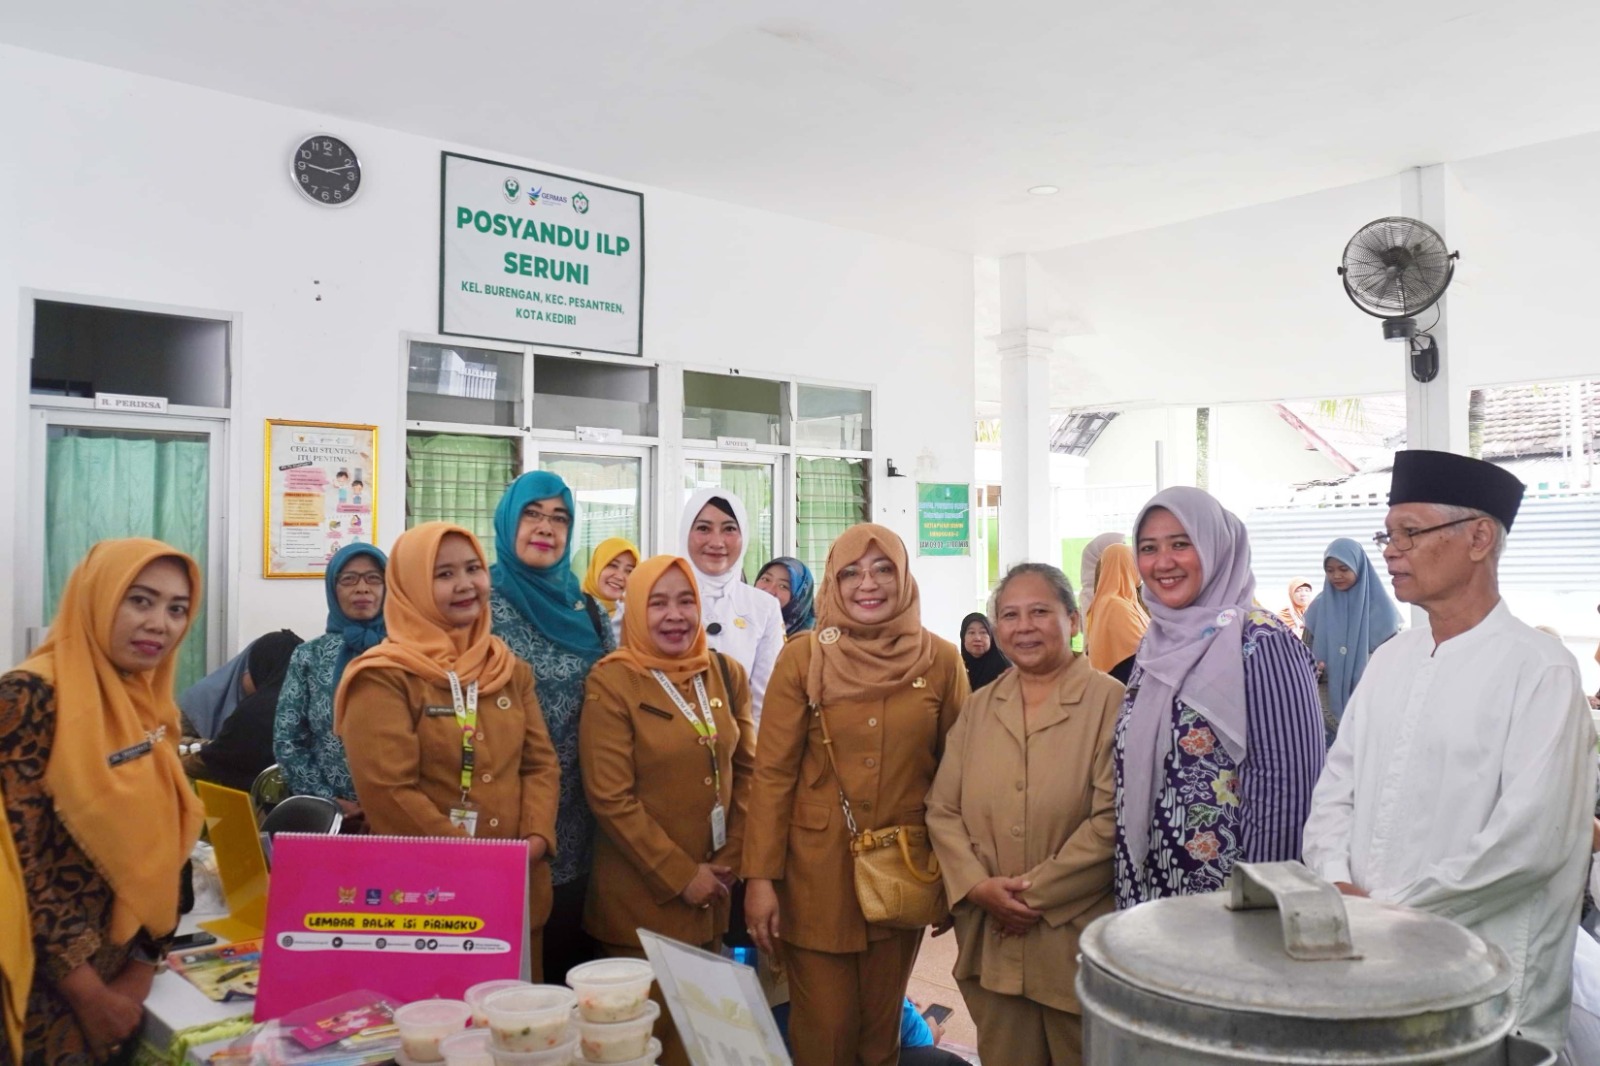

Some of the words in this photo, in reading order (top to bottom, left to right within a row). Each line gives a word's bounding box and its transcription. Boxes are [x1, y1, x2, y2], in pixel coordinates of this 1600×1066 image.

[311, 141, 319, 151] 11
[323, 141, 333, 151] 12
[301, 149, 312, 159] 10
[298, 161, 306, 170] 9
[301, 174, 309, 183] 8
[346, 171, 355, 181] 3
[311, 185, 319, 194] 7
[342, 183, 350, 191] 4
[321, 191, 330, 201] 6
[334, 190, 342, 199] 5
[541, 192, 568, 203] GERMAS
[456, 206, 590, 251] POSYANDU
[596, 232, 631, 256] ILP
[503, 251, 589, 286] SERUNI
[461, 281, 483, 294] KEL.
[484, 284, 543, 304] BURENGAN,
[545, 293, 567, 306] KEC.
[569, 297, 625, 315] PESANTREN,
[515, 308, 543, 321] KOTA
[545, 311, 577, 325] KEDIRI
[115, 399, 161, 409] PERIKSA
[290, 445, 319, 453] CEGAH
[319, 447, 358, 455] STUNTING
[313, 455, 348, 463] PENTING
[308, 916, 355, 928] LEMBAR
